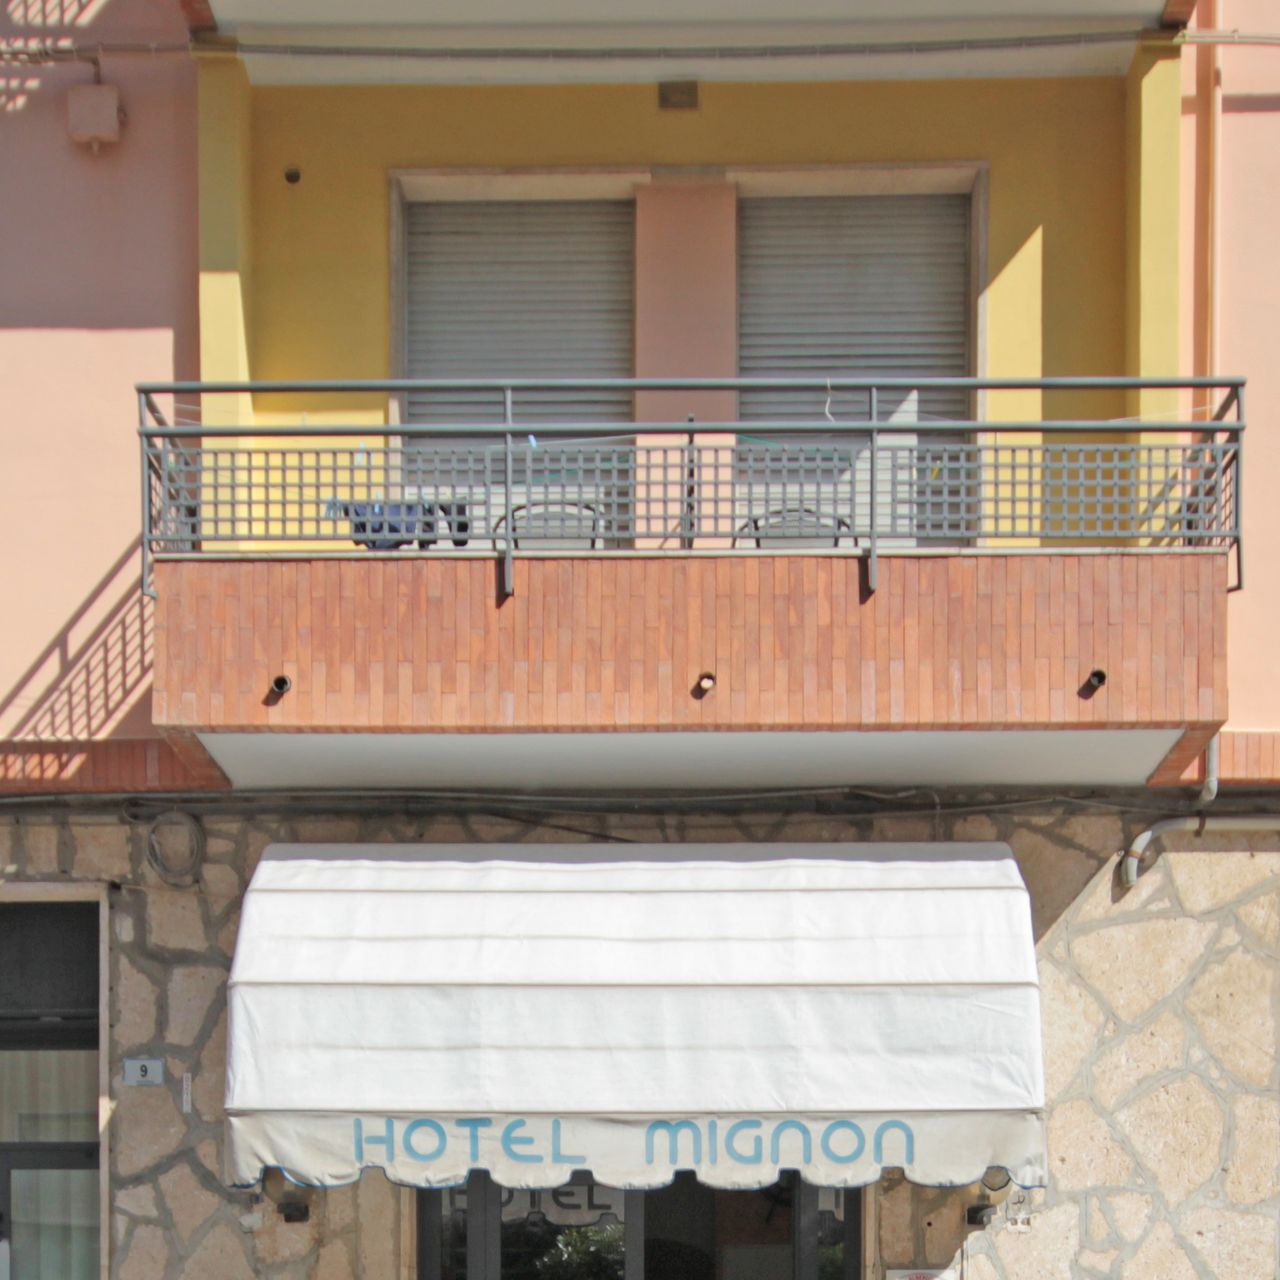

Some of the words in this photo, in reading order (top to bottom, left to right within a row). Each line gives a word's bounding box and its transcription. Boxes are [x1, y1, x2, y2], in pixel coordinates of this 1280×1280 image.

[140, 1064, 148, 1078] 9
[353, 1117, 587, 1164] HOTEL
[645, 1117, 917, 1165] MIGNON
